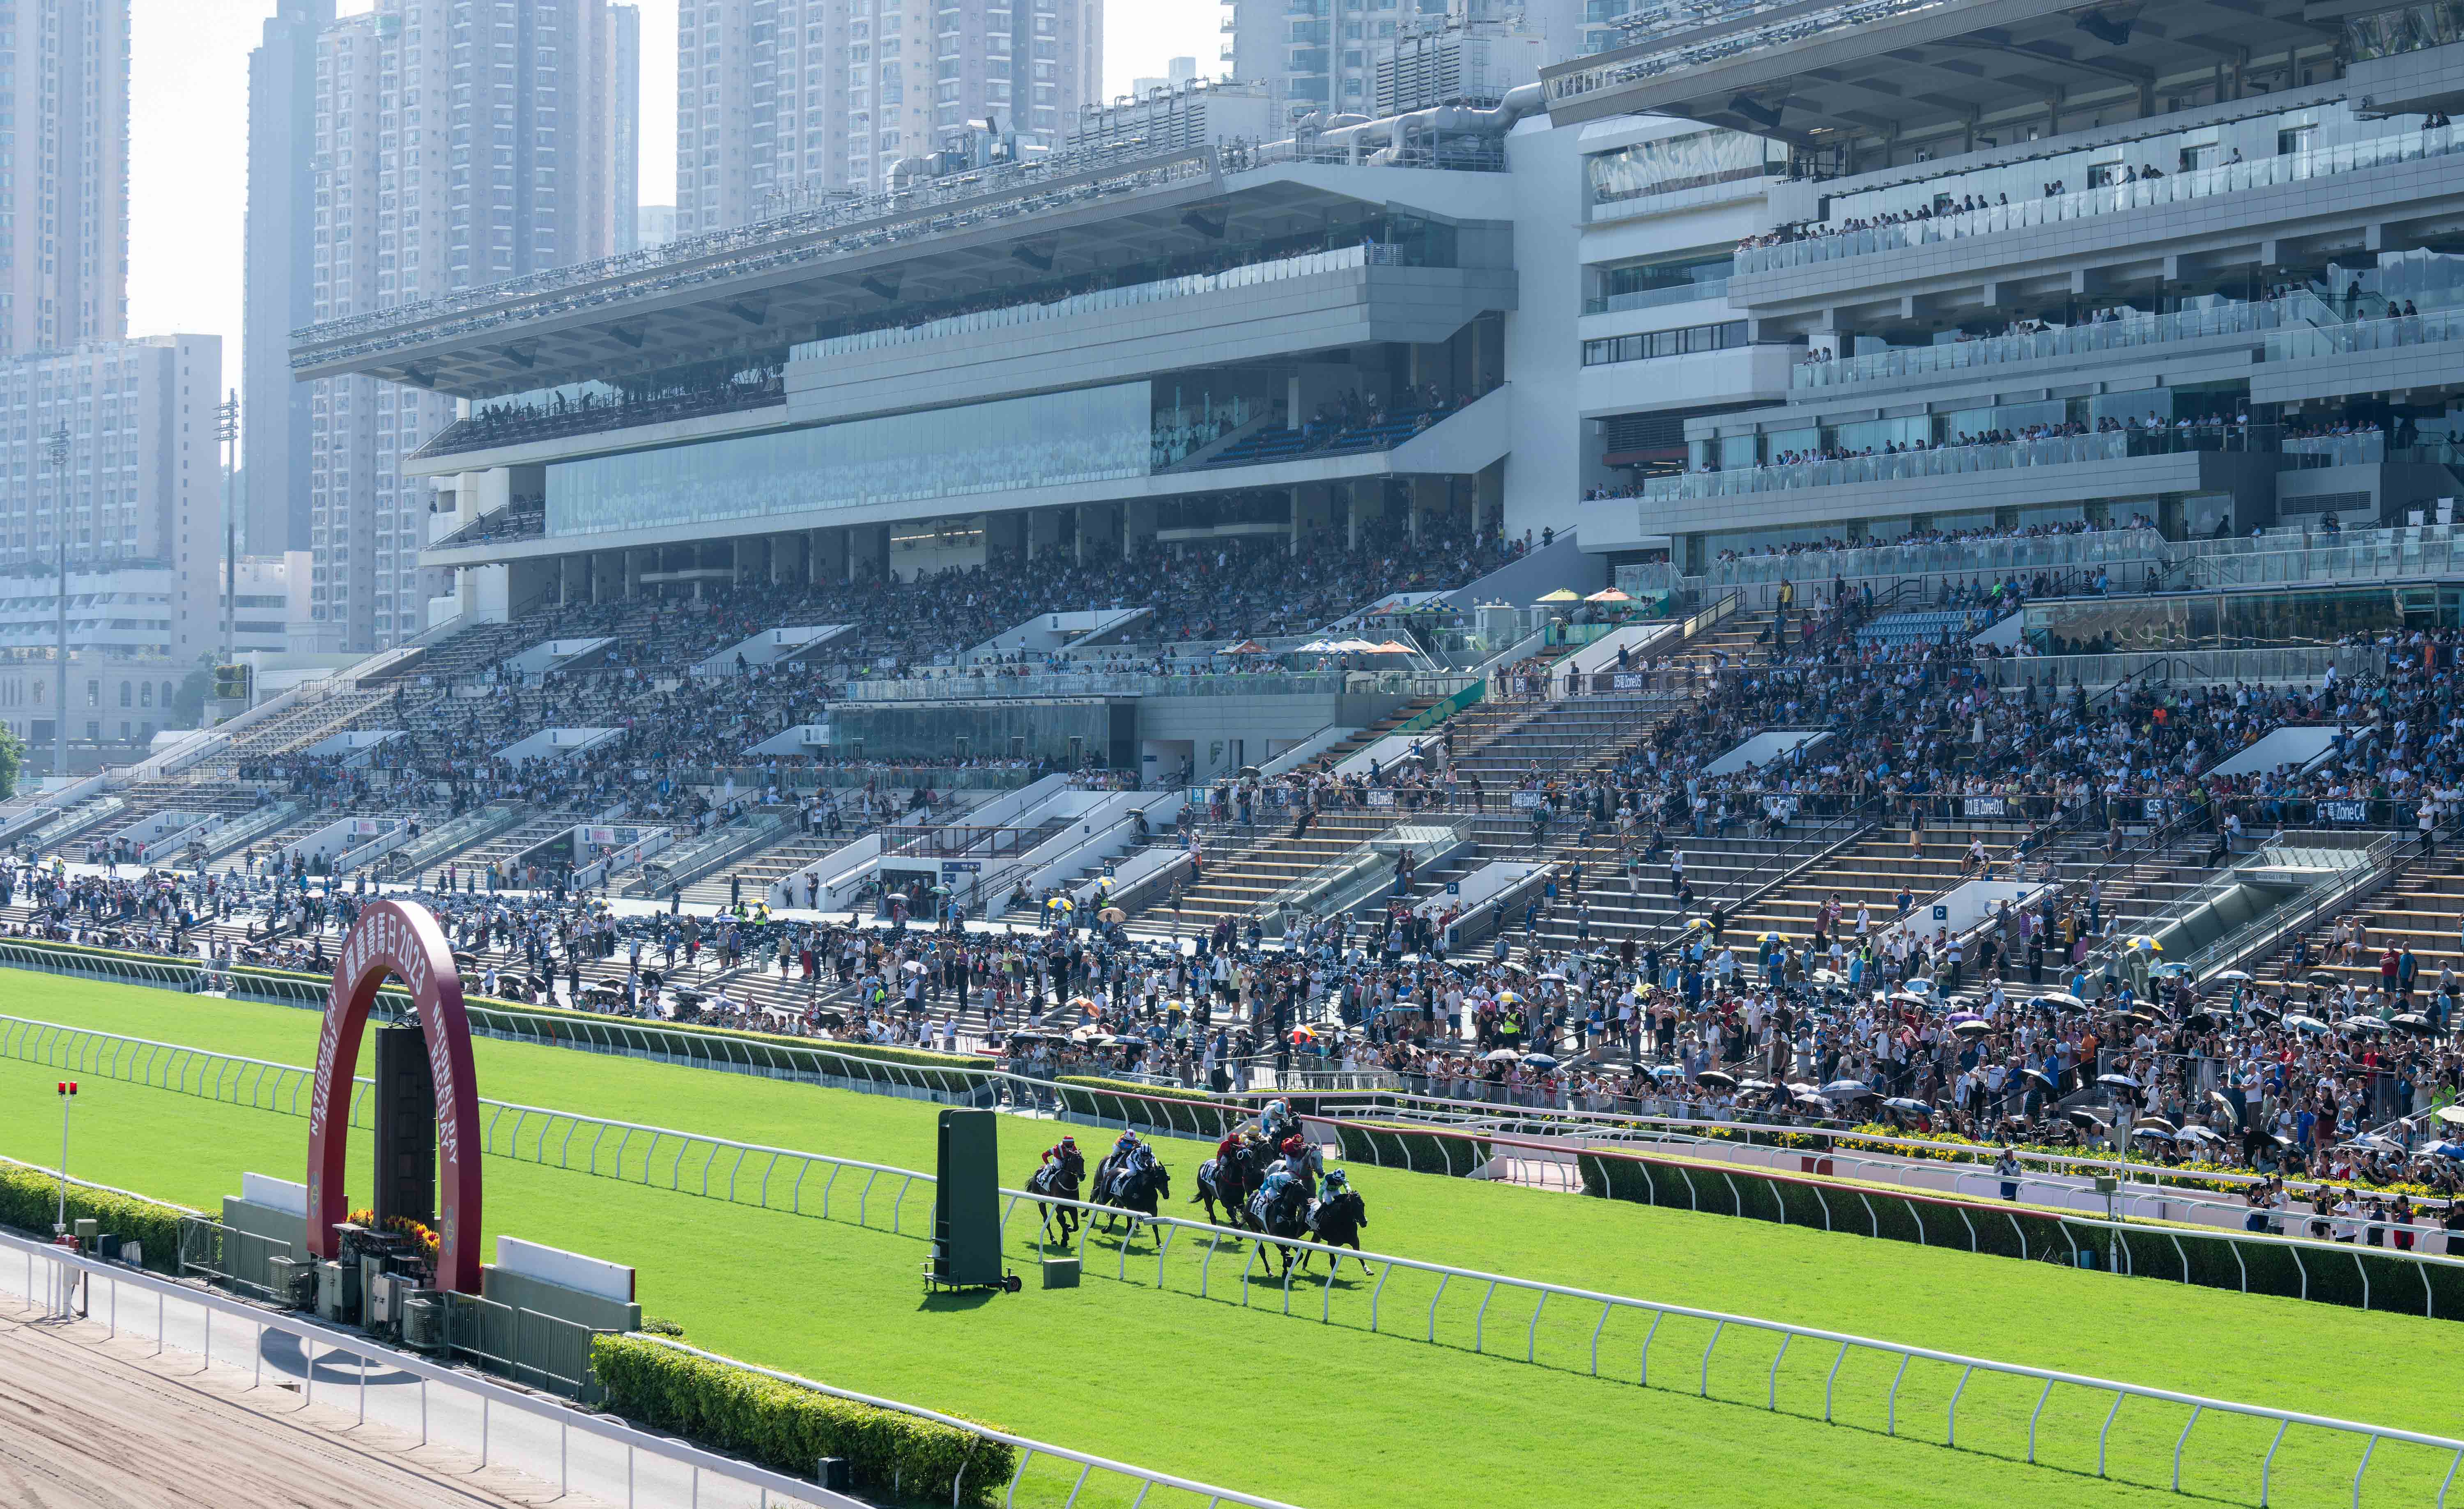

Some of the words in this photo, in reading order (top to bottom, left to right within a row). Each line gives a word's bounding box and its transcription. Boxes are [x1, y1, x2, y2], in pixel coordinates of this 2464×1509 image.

[1516, 678, 1524, 687] D6
[1194, 788, 1202, 798] D6
[1278, 789, 1286, 799] D6
[2147, 799, 2161, 811] C5
[1935, 908, 1943, 917] C
[398, 924, 425, 995] 2023
[311, 1030, 329, 1137] NATIONAL
[326, 984, 338, 1029] DAY
[320, 1021, 338, 1121] RACEDAY
[431, 1042, 449, 1147] RACEDAY
[432, 1000, 453, 1114] NATIONAL
[448, 1119, 457, 1164] DAY
